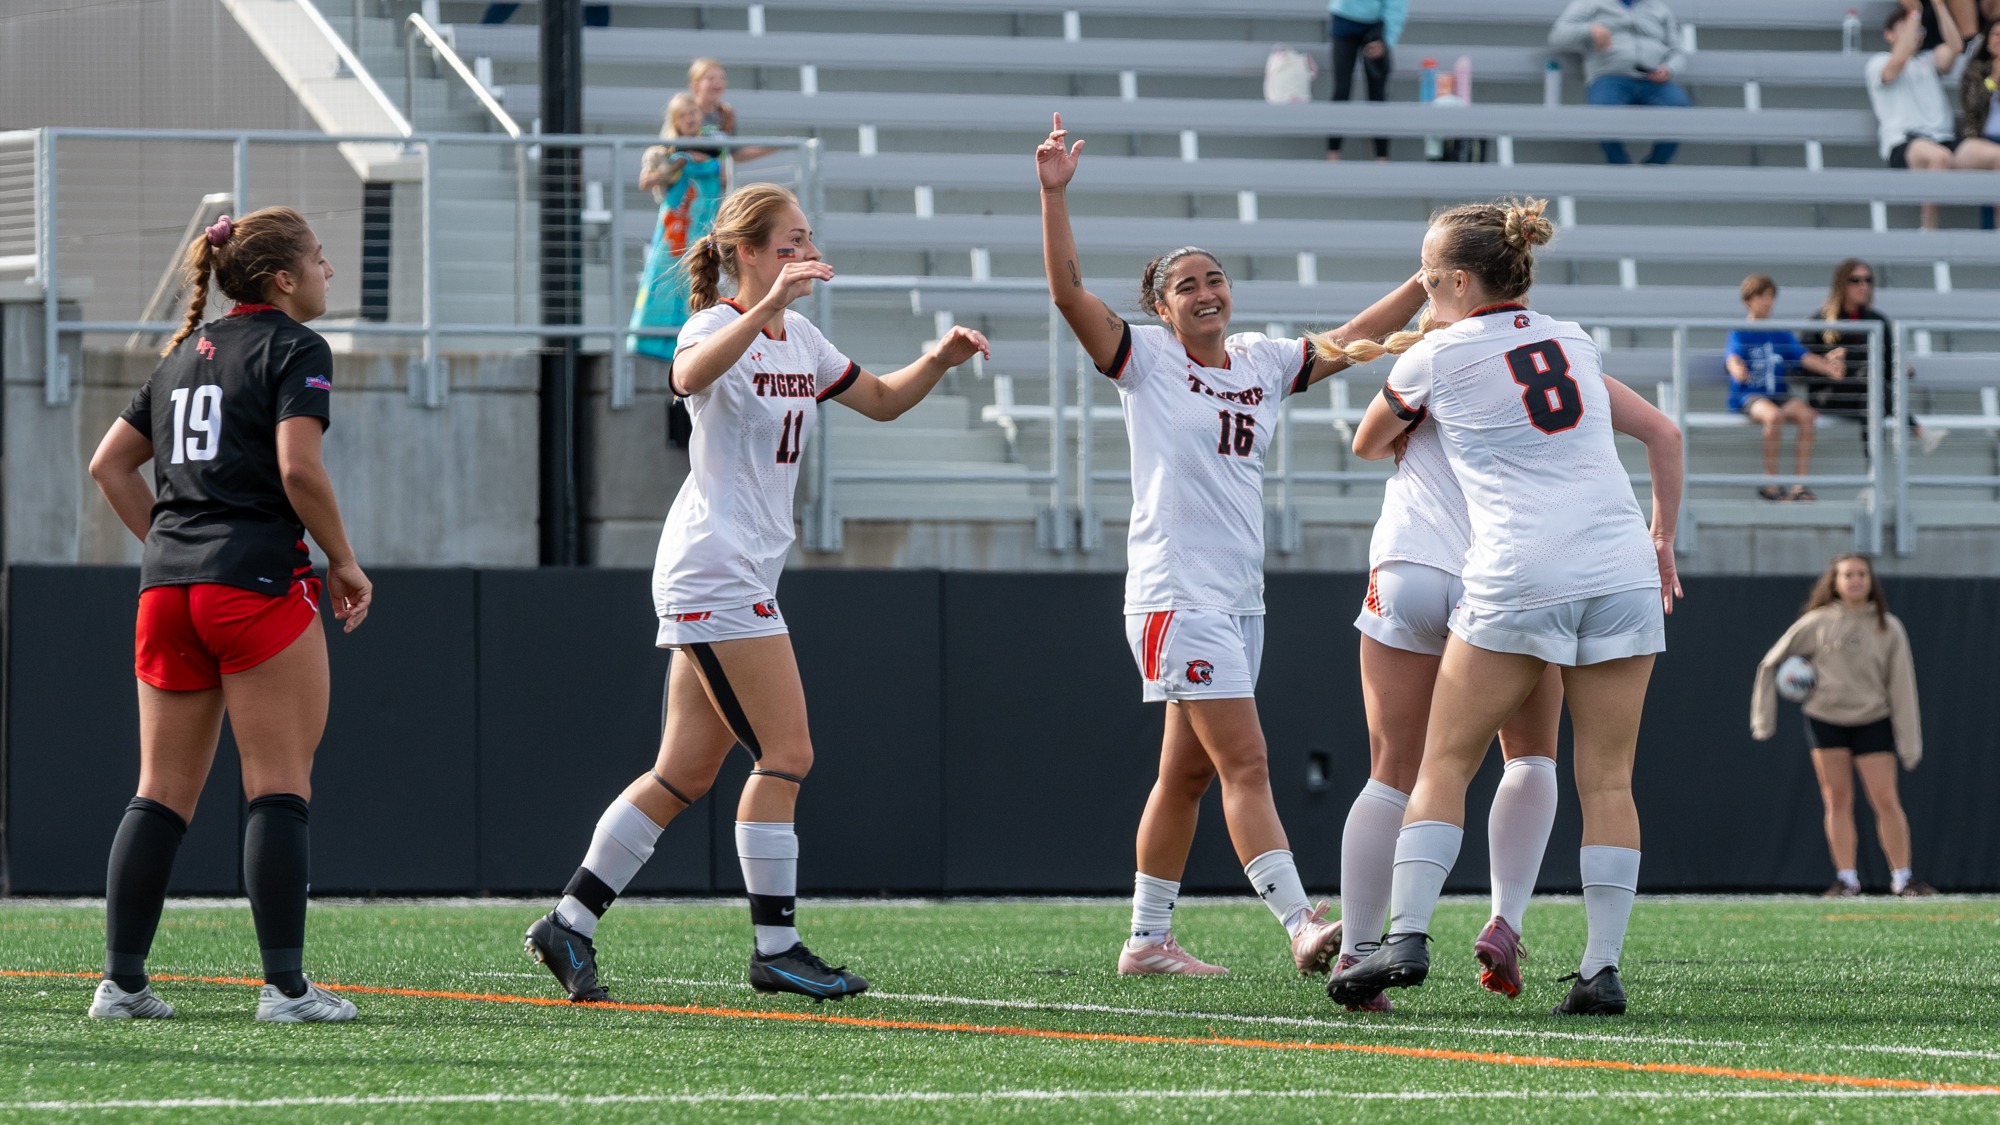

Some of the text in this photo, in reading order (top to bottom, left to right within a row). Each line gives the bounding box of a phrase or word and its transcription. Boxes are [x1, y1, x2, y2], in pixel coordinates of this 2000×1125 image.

[752, 372, 816, 398] TIGERS
[1504, 338, 1585, 436] 8
[170, 384, 224, 464] 19
[776, 410, 804, 464] 11
[1218, 409, 1257, 457] 16
